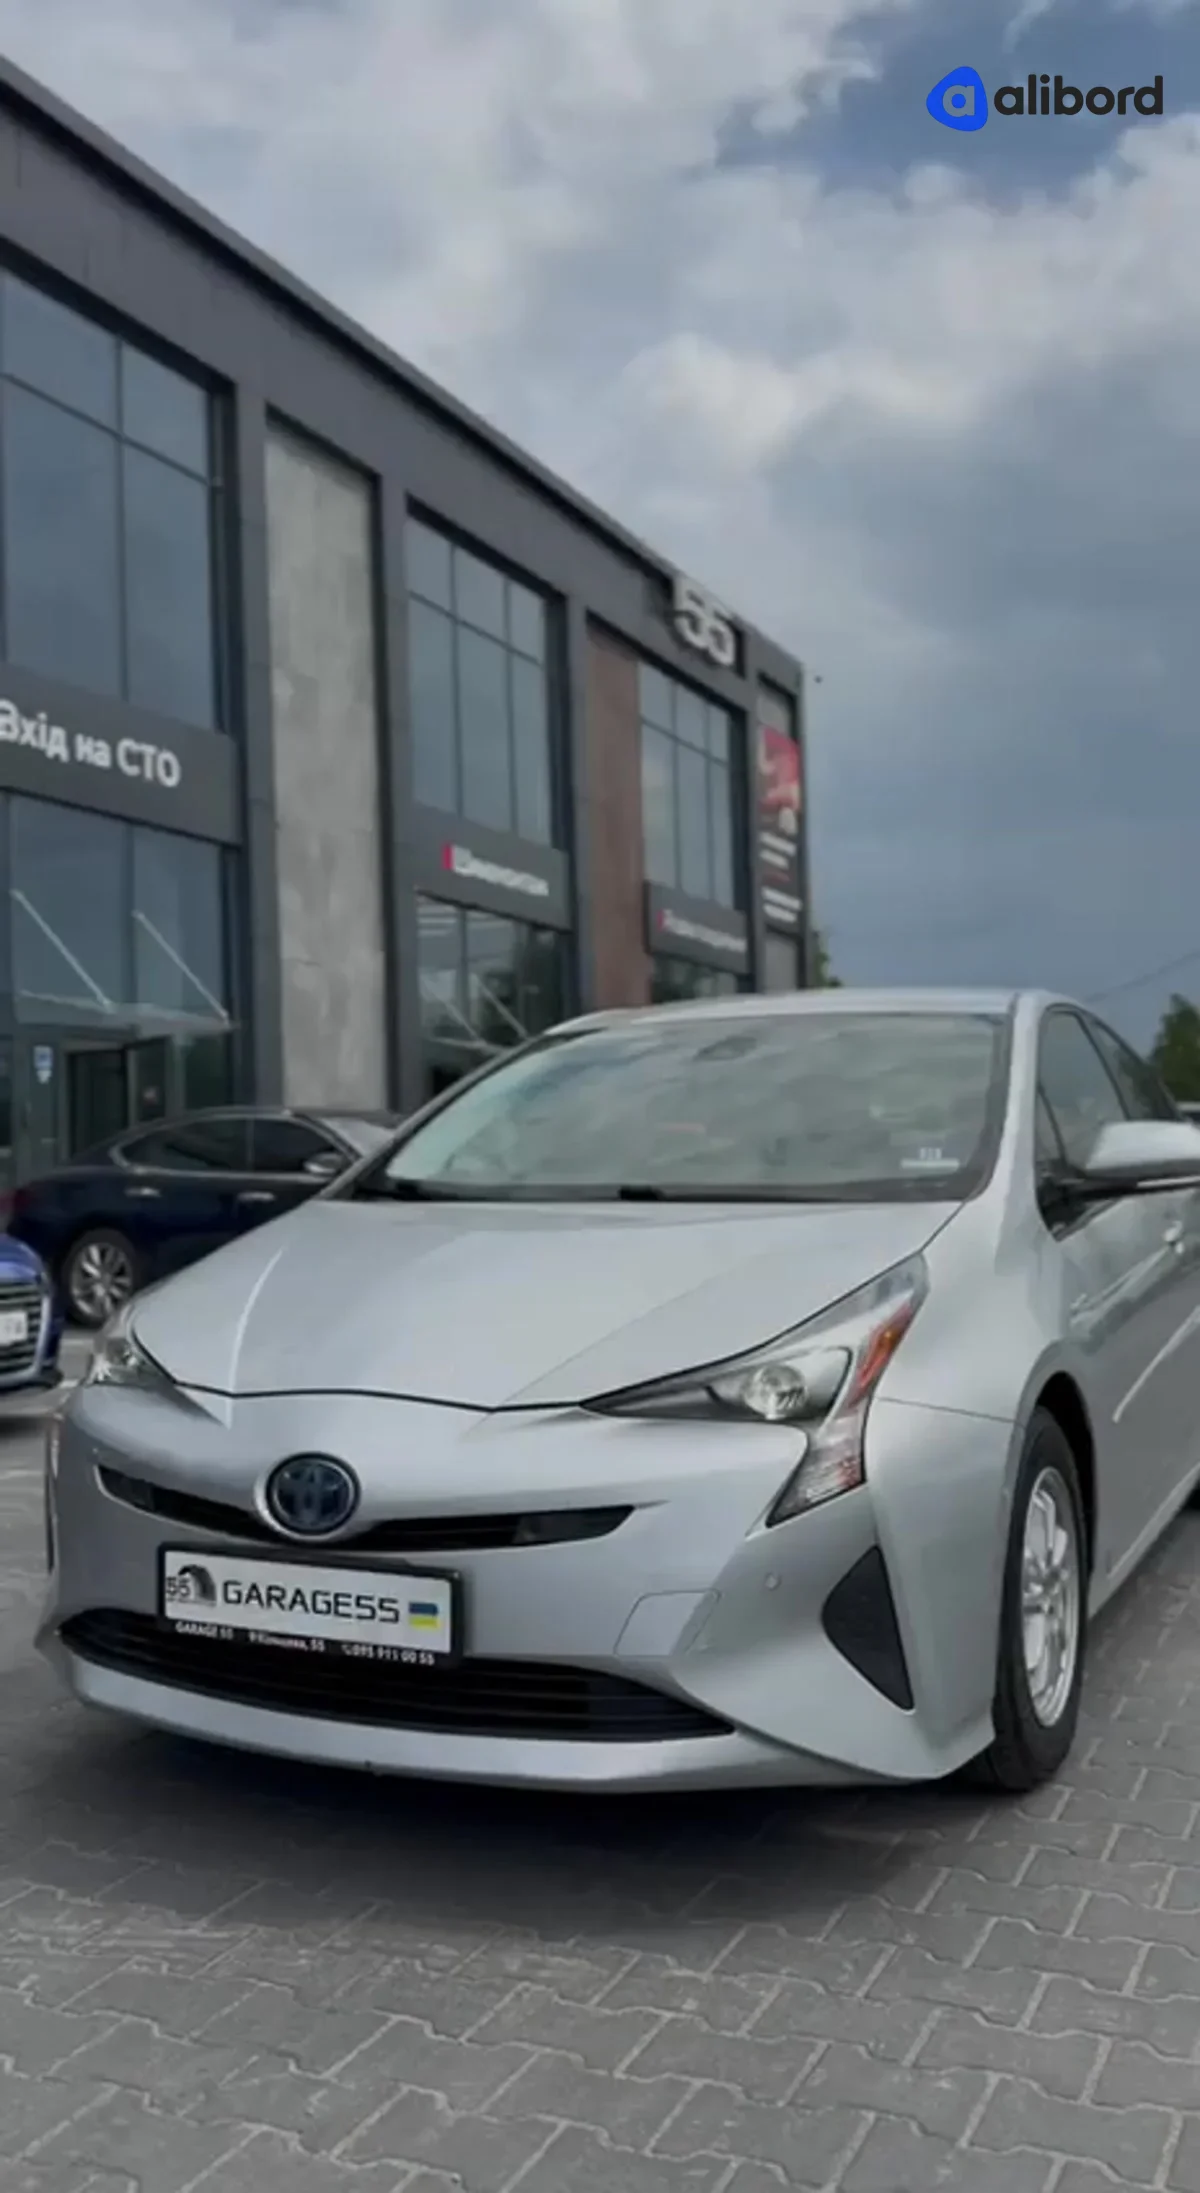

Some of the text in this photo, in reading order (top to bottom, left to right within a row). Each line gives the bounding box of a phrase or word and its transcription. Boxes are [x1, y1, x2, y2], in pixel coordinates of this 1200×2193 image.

[673, 578, 735, 667] 55
[75, 732, 112, 769] на
[117, 738, 182, 788] СТО
[175, 1621, 217, 1638] GARAGE
